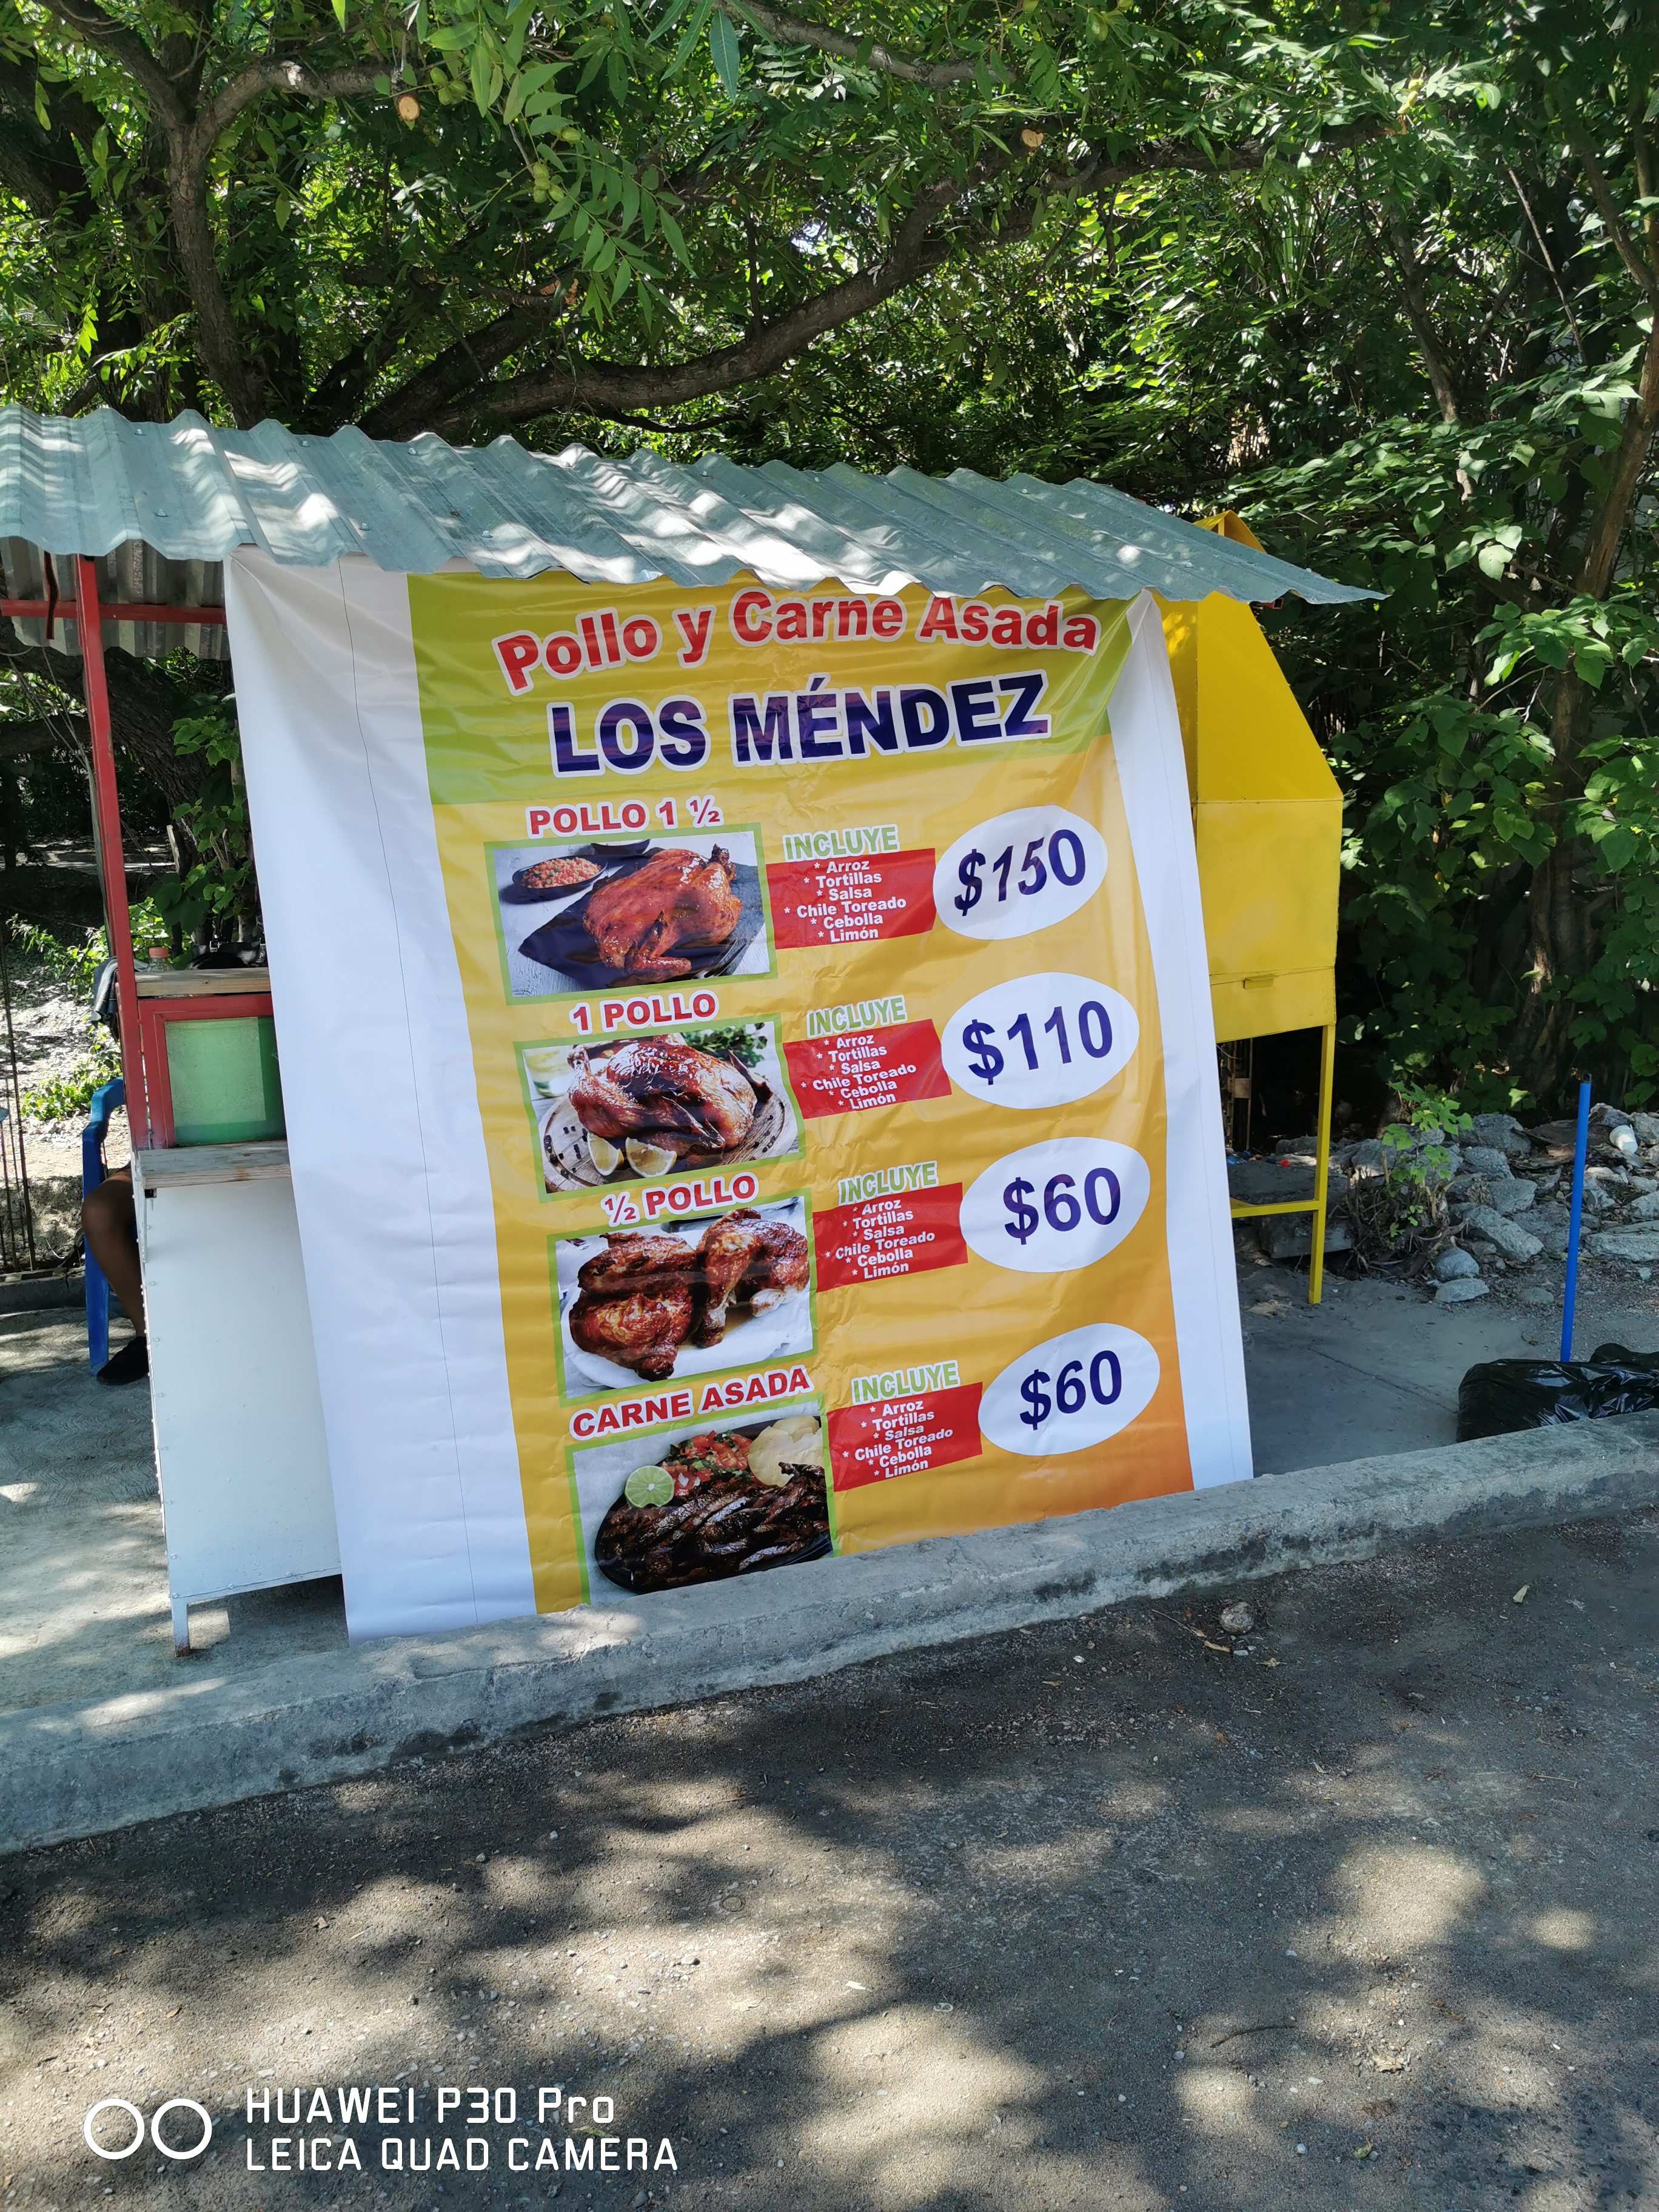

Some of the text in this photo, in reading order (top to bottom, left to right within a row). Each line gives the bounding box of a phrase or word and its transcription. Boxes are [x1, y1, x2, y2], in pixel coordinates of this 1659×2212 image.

[496, 591, 1097, 691] Pollo y Carne Asada
[551, 673, 1049, 773] LOS MÉNDEZ
[529, 803, 646, 836] POLLO
[659, 800, 674, 826] 1
[784, 826, 899, 860] INCLUYE
[826, 860, 870, 873] Arroz
[954, 828, 1086, 917] $150
[815, 871, 883, 888] Tortillas
[828, 886, 873, 901] Salsa
[796, 897, 907, 919] Chile Toreado
[823, 913, 884, 930] Cebolla
[830, 928, 879, 943] Limón
[572, 993, 717, 1031] 1 POLLO
[806, 996, 907, 1037] INCLUYE
[836, 1034, 874, 1048] Arroz
[962, 1000, 1113, 1085] $110
[828, 1045, 888, 1062] Tortillas
[813, 1062, 917, 1091] Chile Toreado
[840, 1060, 881, 1074] Salsa
[840, 1079, 898, 1099] Cebolla
[851, 1092, 896, 1110] Limón
[838, 1161, 938, 1204] INCLUYE
[645, 1175, 757, 1216] POLLO
[862, 1198, 902, 1215] Arroz
[1003, 1167, 1121, 1245] $60
[853, 1209, 914, 1230] Tortillas
[863, 1224, 905, 1241] Salsa
[835, 1230, 936, 1260] Chile Toreado
[857, 1248, 914, 1268] Cebolla
[863, 1261, 910, 1279] Limón
[852, 1361, 959, 1404] INCLUYE
[1019, 1349, 1122, 1431] $60
[572, 1367, 811, 1438] CARNE ASADA
[882, 1399, 924, 1417] Arroz
[872, 1410, 935, 1432] Tortillas
[884, 1424, 924, 1441] Salsa
[854, 1427, 954, 1461] Chile Toreado
[879, 1444, 933, 1468] Cebolla
[885, 1459, 929, 1479] Limón
